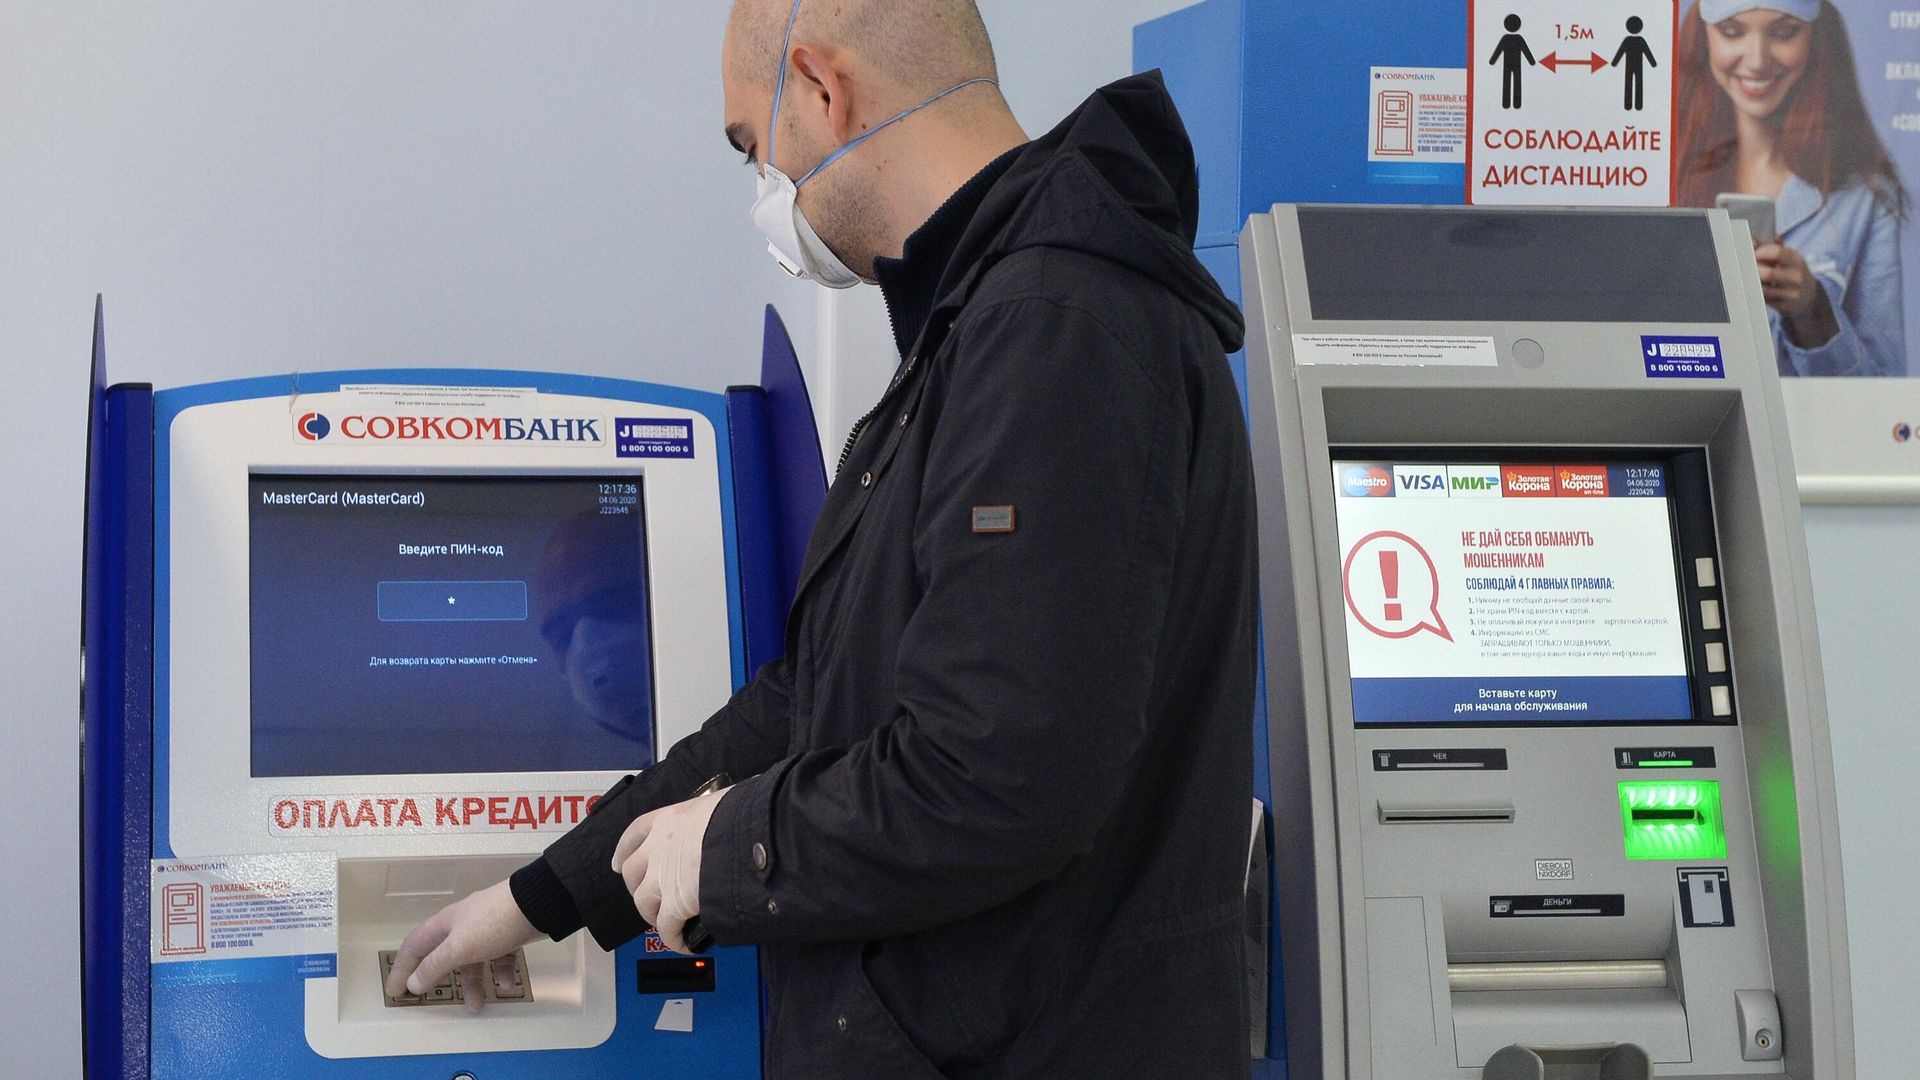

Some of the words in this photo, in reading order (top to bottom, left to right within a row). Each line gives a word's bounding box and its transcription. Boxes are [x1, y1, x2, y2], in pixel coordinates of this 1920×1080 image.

[1555, 24, 1594, 40] 1,5м
[1484, 125, 1661, 153] СОБЛЮДАЙТЕ
[1482, 165, 1648, 189] ДИСТАНЦИЮ
[1694, 364, 1710, 372] 000
[341, 416, 601, 442] СОВКОМБАНК
[1518, 475, 1550, 483] Золотая
[1571, 473, 1603, 481] Золотая
[1626, 469, 1660, 478] 12:17:40
[1347, 476, 1387, 487] Maestro
[1397, 474, 1445, 490] VISA
[1452, 476, 1499, 490] МИР
[1508, 481, 1550, 493] Корона
[1562, 479, 1604, 492] Корона
[599, 484, 637, 494] 12:17:36
[263, 491, 338, 505] MasterCard
[341, 491, 425, 507] (MasterCard)
[599, 496, 637, 504] 04.06.2020
[1461, 531, 1475, 547] НЕ
[1479, 528, 1502, 548] ДАЙ
[1504, 531, 1532, 547] СЕБЯ
[1535, 531, 1594, 547] ОБМАНУТЬ
[399, 544, 447, 556] Введите
[450, 544, 504, 556] ПИН-код
[1464, 553, 1544, 568] МОШЕННИКАМ
[1466, 575, 1516, 591] СОБЛЮДАЙ
[1518, 578, 1524, 590] 4
[1571, 577, 1615, 591] ПРАВИЛА:
[370, 656, 387, 666] Для
[389, 657, 429, 667] возврата
[430, 657, 457, 666] карты
[458, 657, 496, 665] нажмите
[1478, 688, 1526, 699] Вставьте
[1528, 690, 1558, 700] карту
[1454, 702, 1473, 713] для
[1475, 702, 1512, 711] начала
[1514, 700, 1588, 712] обслуживания
[1432, 752, 1448, 760] ЧЕК
[1653, 751, 1677, 759] КАРТА
[274, 797, 422, 829] ОПЛАТА
[1543, 898, 1572, 907] ДЕНЬГИ
